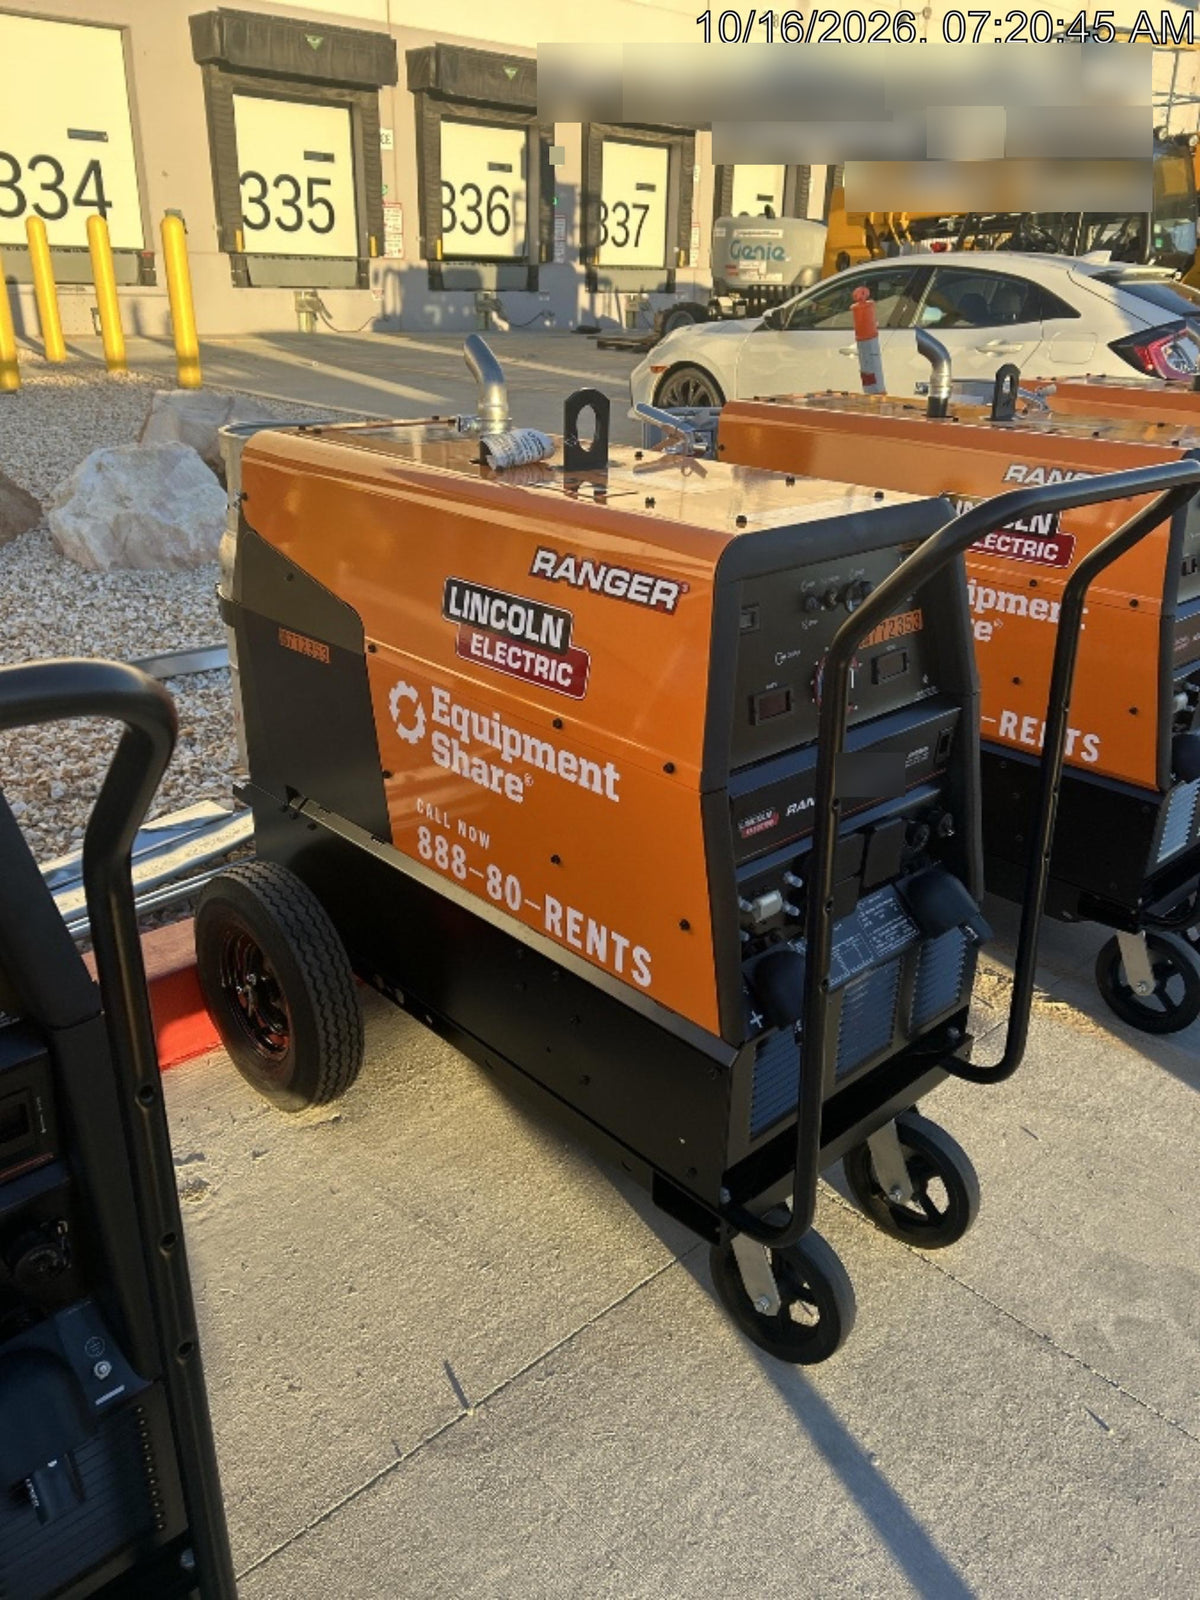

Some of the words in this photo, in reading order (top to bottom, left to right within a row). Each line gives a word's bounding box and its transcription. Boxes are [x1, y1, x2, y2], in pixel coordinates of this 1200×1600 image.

[0, 151, 112, 221] 334
[239, 171, 335, 234] 335
[729, 240, 786, 262] Genie
[448, 586, 565, 647] LINCOLN
[470, 634, 573, 687] ELECTRIC
[430, 685, 621, 803] Equipment
[416, 798, 451, 831] CALL
[457, 822, 491, 850] NOW
[416, 826, 653, 988] 888-80-RENTS
